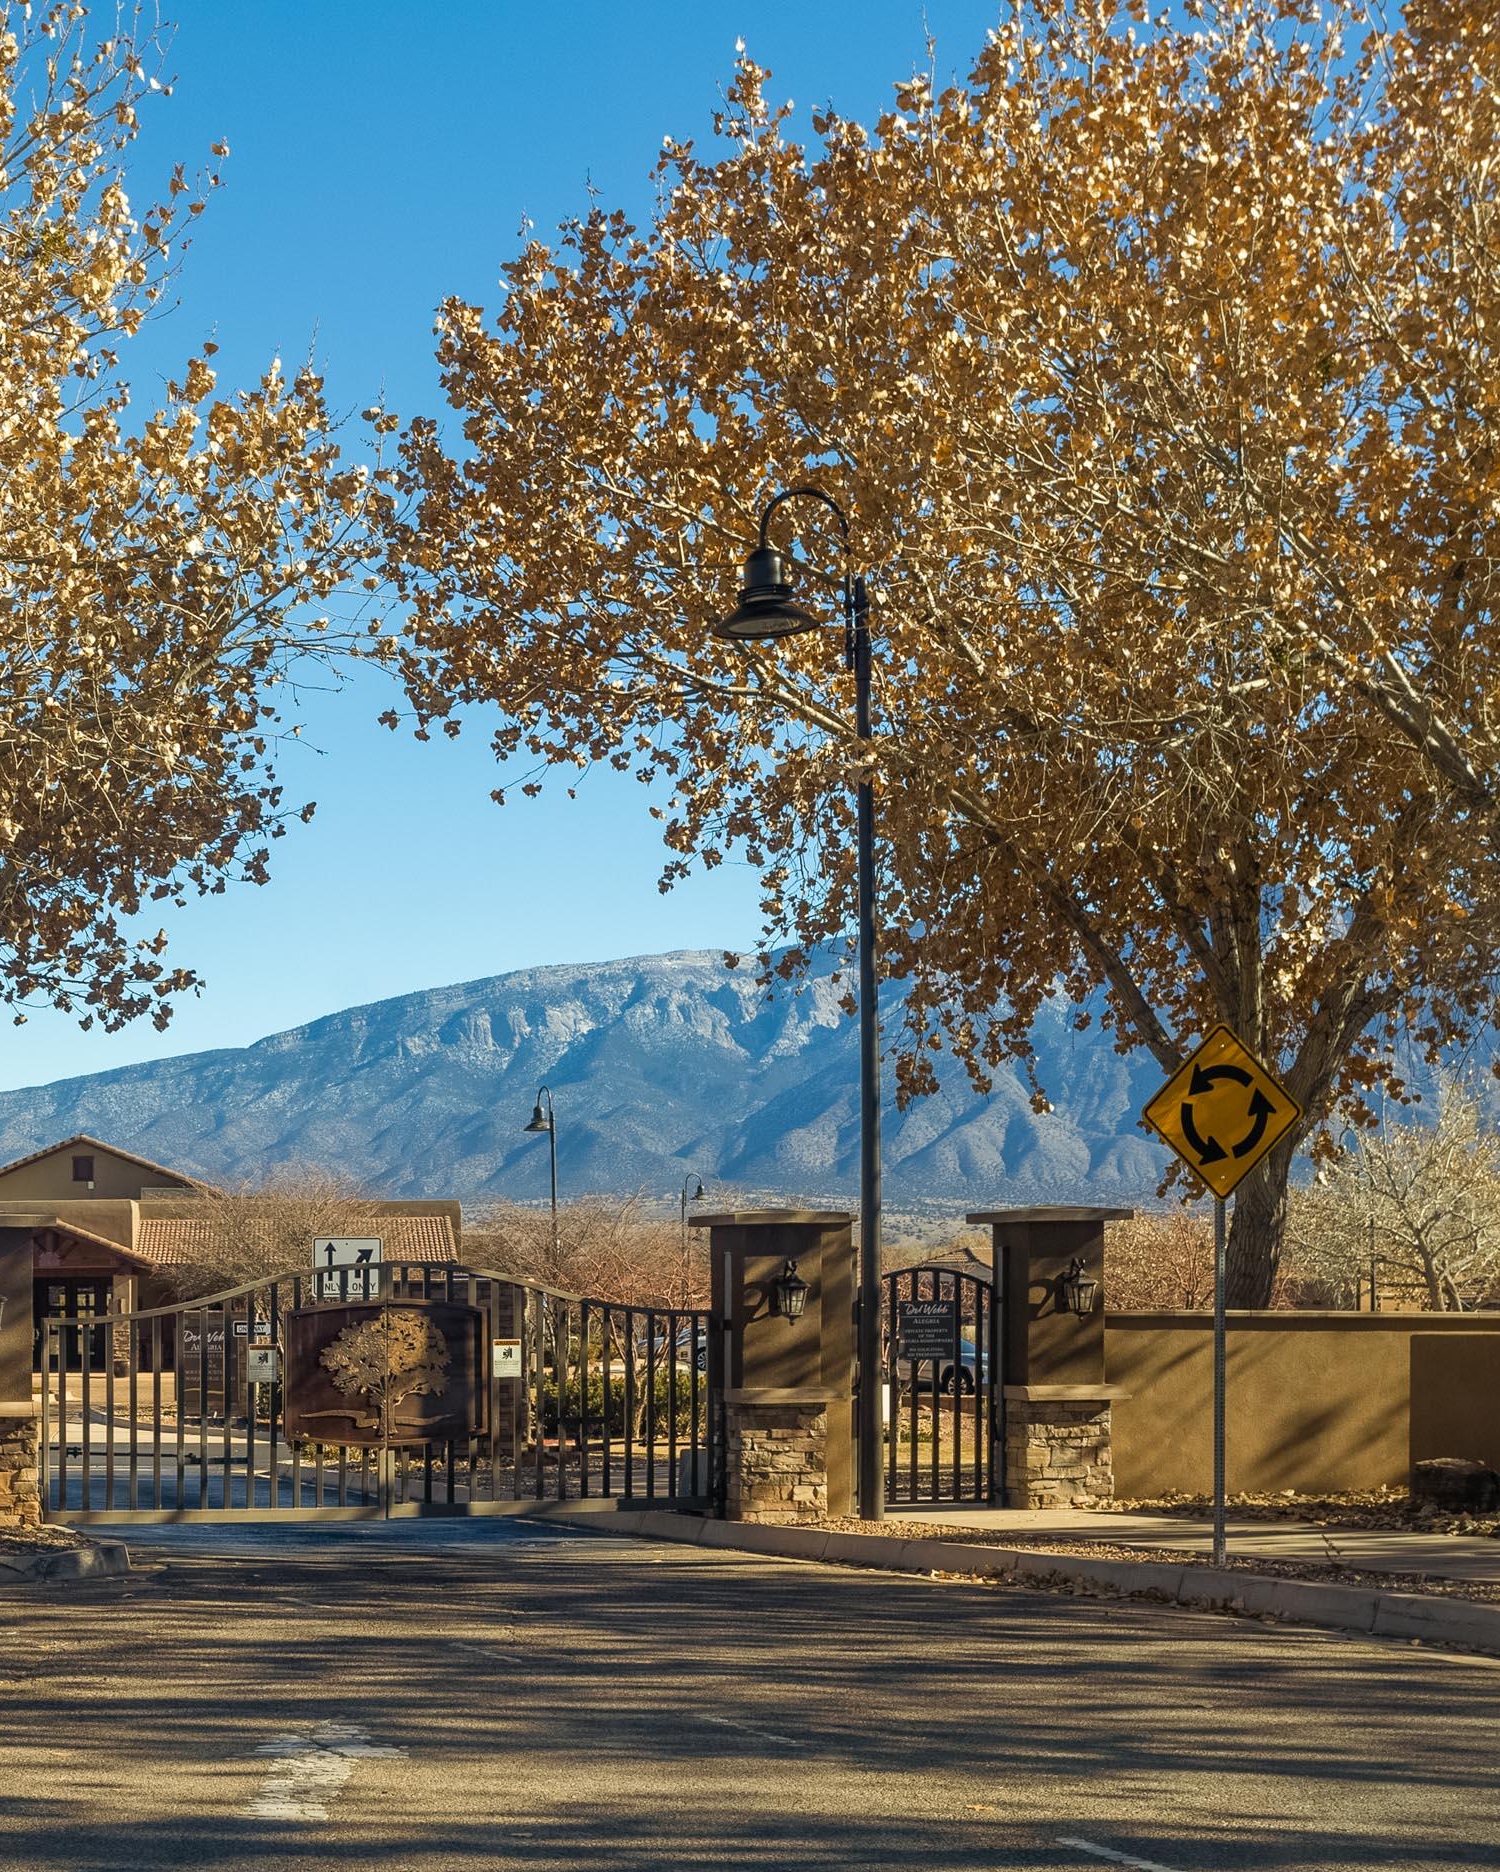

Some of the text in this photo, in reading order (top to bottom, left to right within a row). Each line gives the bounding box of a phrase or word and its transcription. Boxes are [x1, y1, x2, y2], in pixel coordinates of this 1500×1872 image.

[351, 1282, 377, 1292] ONY
[905, 1303, 949, 1315] Del Webb
